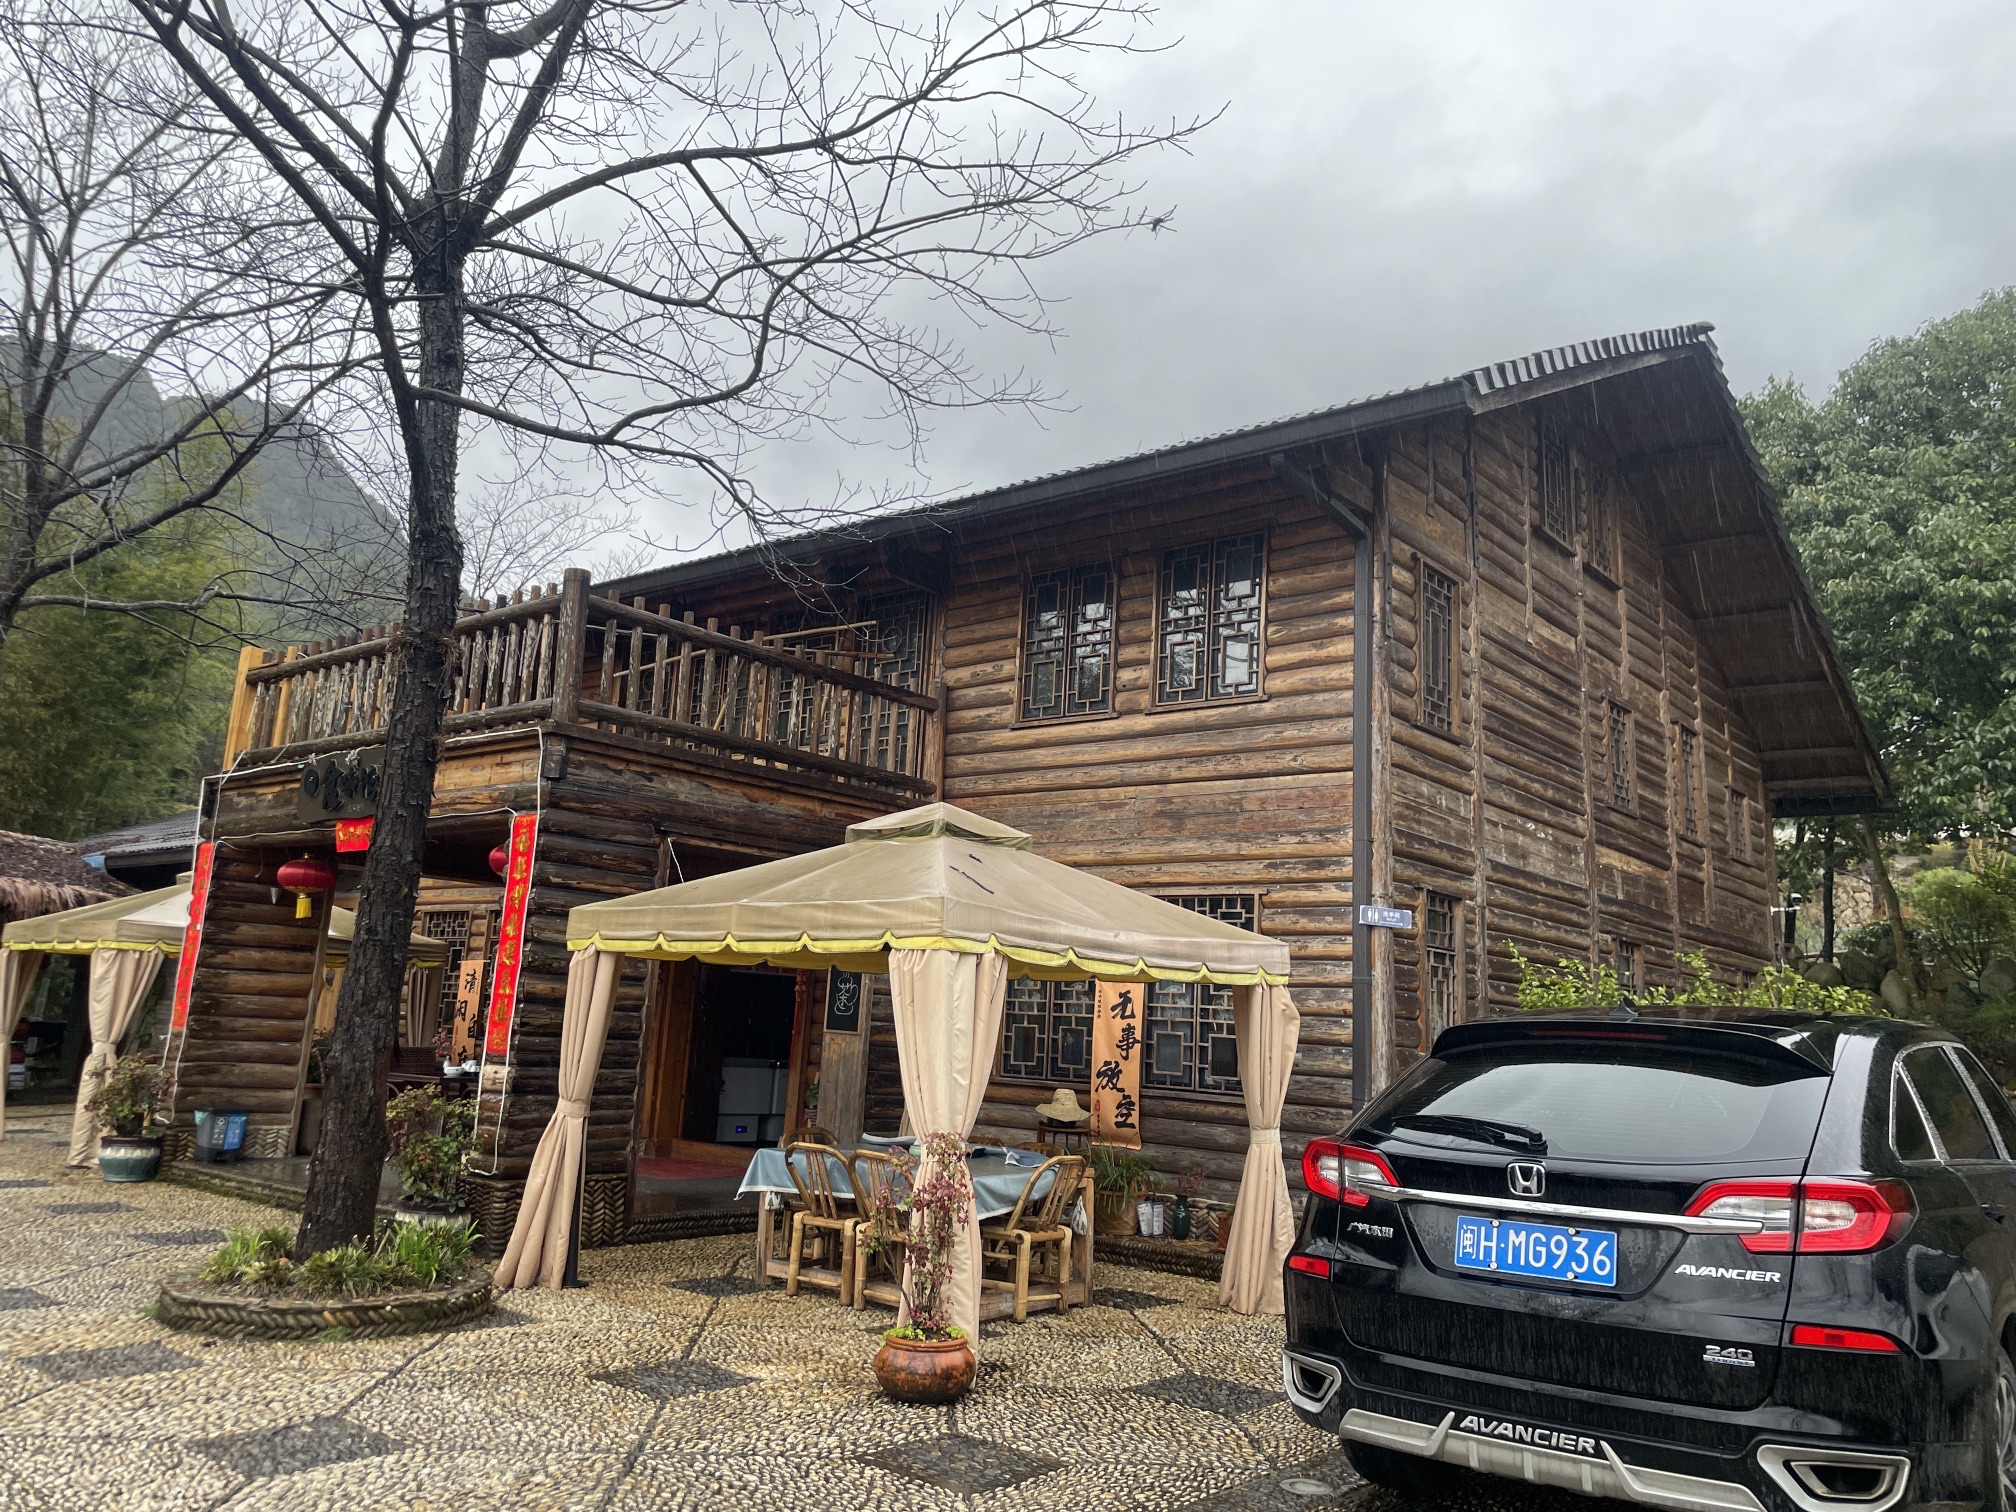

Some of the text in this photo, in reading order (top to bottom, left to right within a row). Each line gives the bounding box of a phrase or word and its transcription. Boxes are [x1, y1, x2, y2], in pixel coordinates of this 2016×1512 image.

[1095, 989, 1142, 1130] 无事放空
[1347, 1222, 1394, 1239] 广汽本田
[1674, 1264, 1781, 1283] AVANCIER
[1705, 1345, 1753, 1361] 240
[1459, 1415, 1596, 1454] AVANCIER
